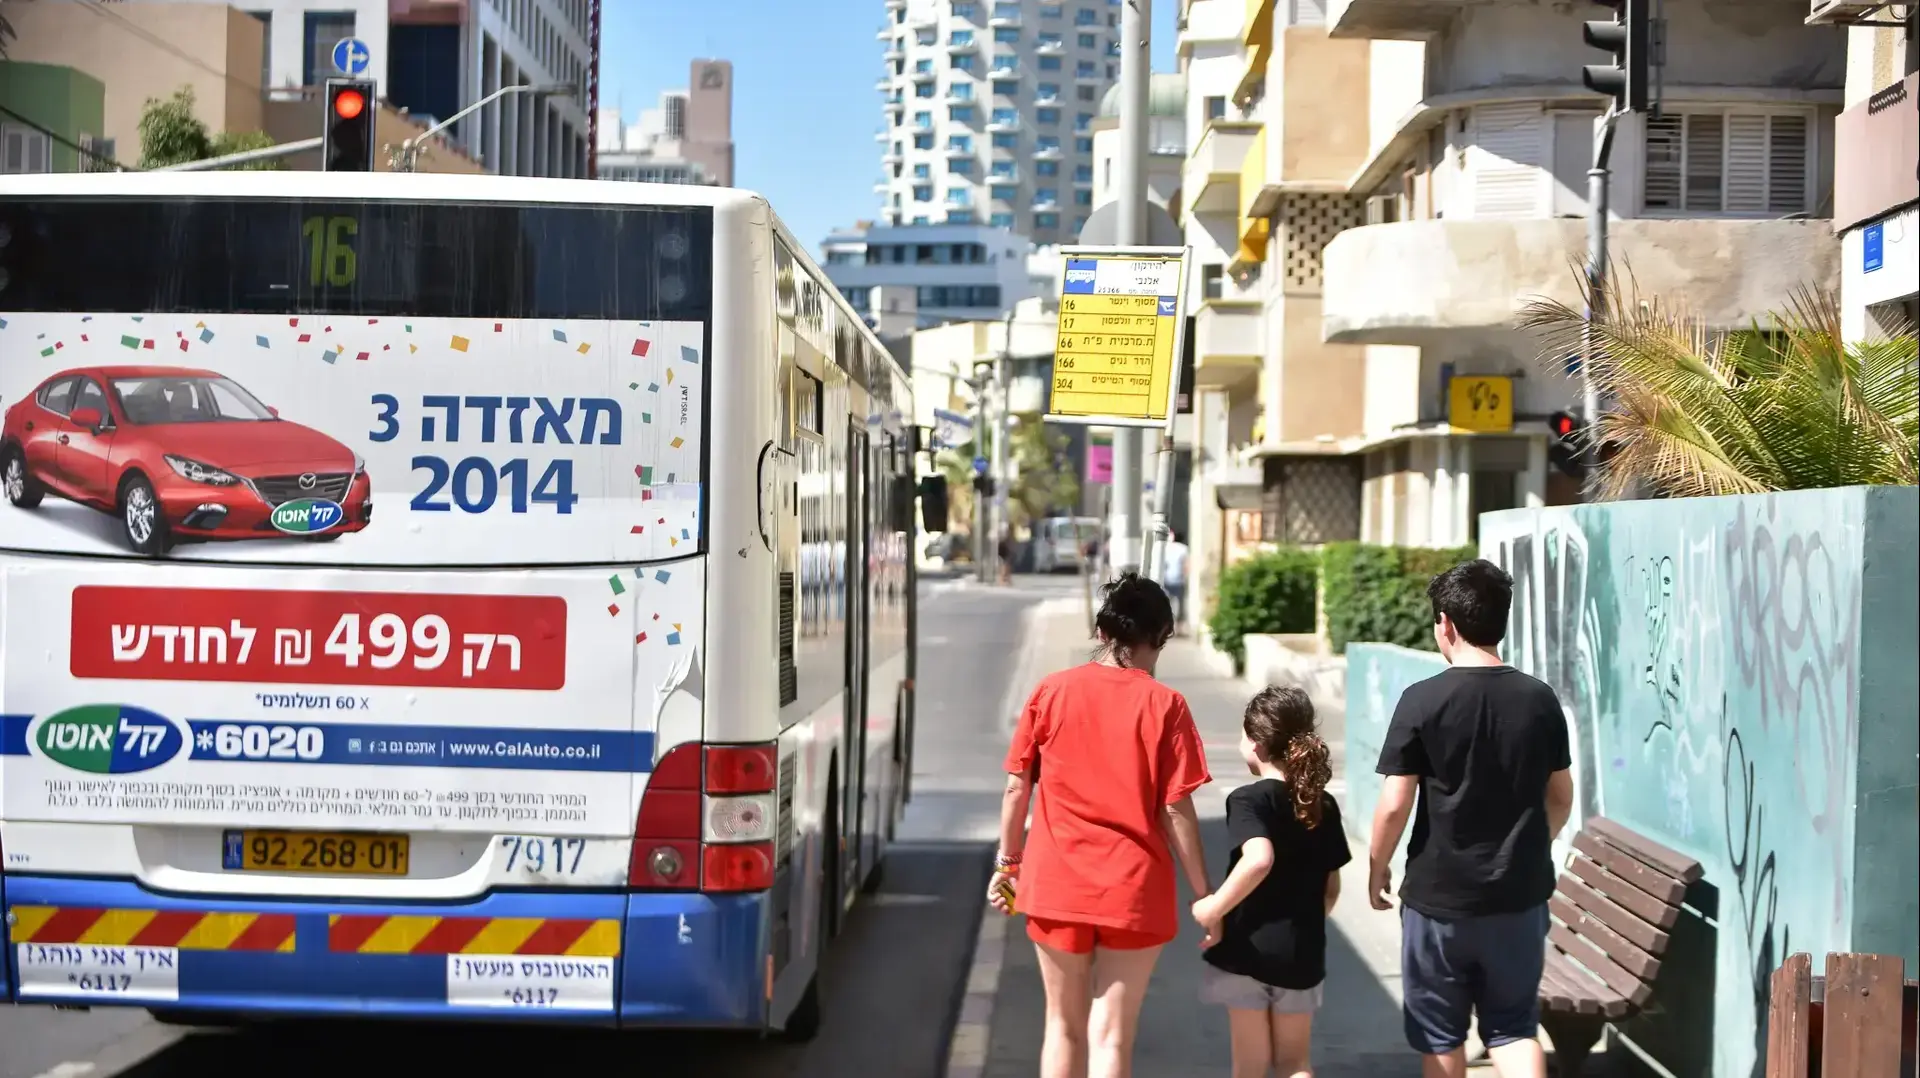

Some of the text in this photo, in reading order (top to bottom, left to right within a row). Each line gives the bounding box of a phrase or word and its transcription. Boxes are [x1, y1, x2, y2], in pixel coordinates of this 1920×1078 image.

[303, 216, 358, 287] 16
[1135, 277, 1160, 285] אלנבי
[1065, 300, 1076, 310] 16
[1135, 298, 1156, 307] מסוף
[1063, 318, 1074, 328] 17
[1060, 338, 1073, 348] 66
[1058, 357, 1151, 368] הדר גנים 166
[1056, 378, 1073, 389] 304
[1130, 378, 1150, 387] מסוף
[368, 393, 623, 445] מאזדה 3
[410, 455, 579, 514] 2014
[277, 505, 335, 524] קל אוטו
[111, 613, 522, 679] רק 499 ₪ לחודש
[336, 697, 355, 710] 60
[46, 717, 168, 759] קל אוטו
[389, 741, 403, 754] גם
[405, 741, 436, 755] אתכם
[450, 741, 601, 760] www.CalAuto.co.il
[76, 779, 116, 795] לאישור
[162, 783, 203, 798] תקופה
[206, 783, 235, 799] בסוף
[239, 784, 282, 798] אופציה
[296, 786, 340, 800] מקדמה
[355, 787, 400, 801] חודשים
[116, 795, 169, 810] להמחשה
[174, 797, 224, 811] התמונות
[476, 791, 496, 806] בסך
[500, 792, 544, 805] החודשי
[549, 793, 587, 806] המחיר
[267, 799, 306, 813] כוללים
[310, 801, 361, 815] המחירים
[409, 803, 432, 817] גמר
[437, 804, 452, 818] עד
[502, 807, 538, 821] בכפוף
[502, 835, 586, 874] 7917
[91, 946, 126, 966] אני
[135, 948, 173, 971] איך
[521, 960, 610, 979] האוטובוס
